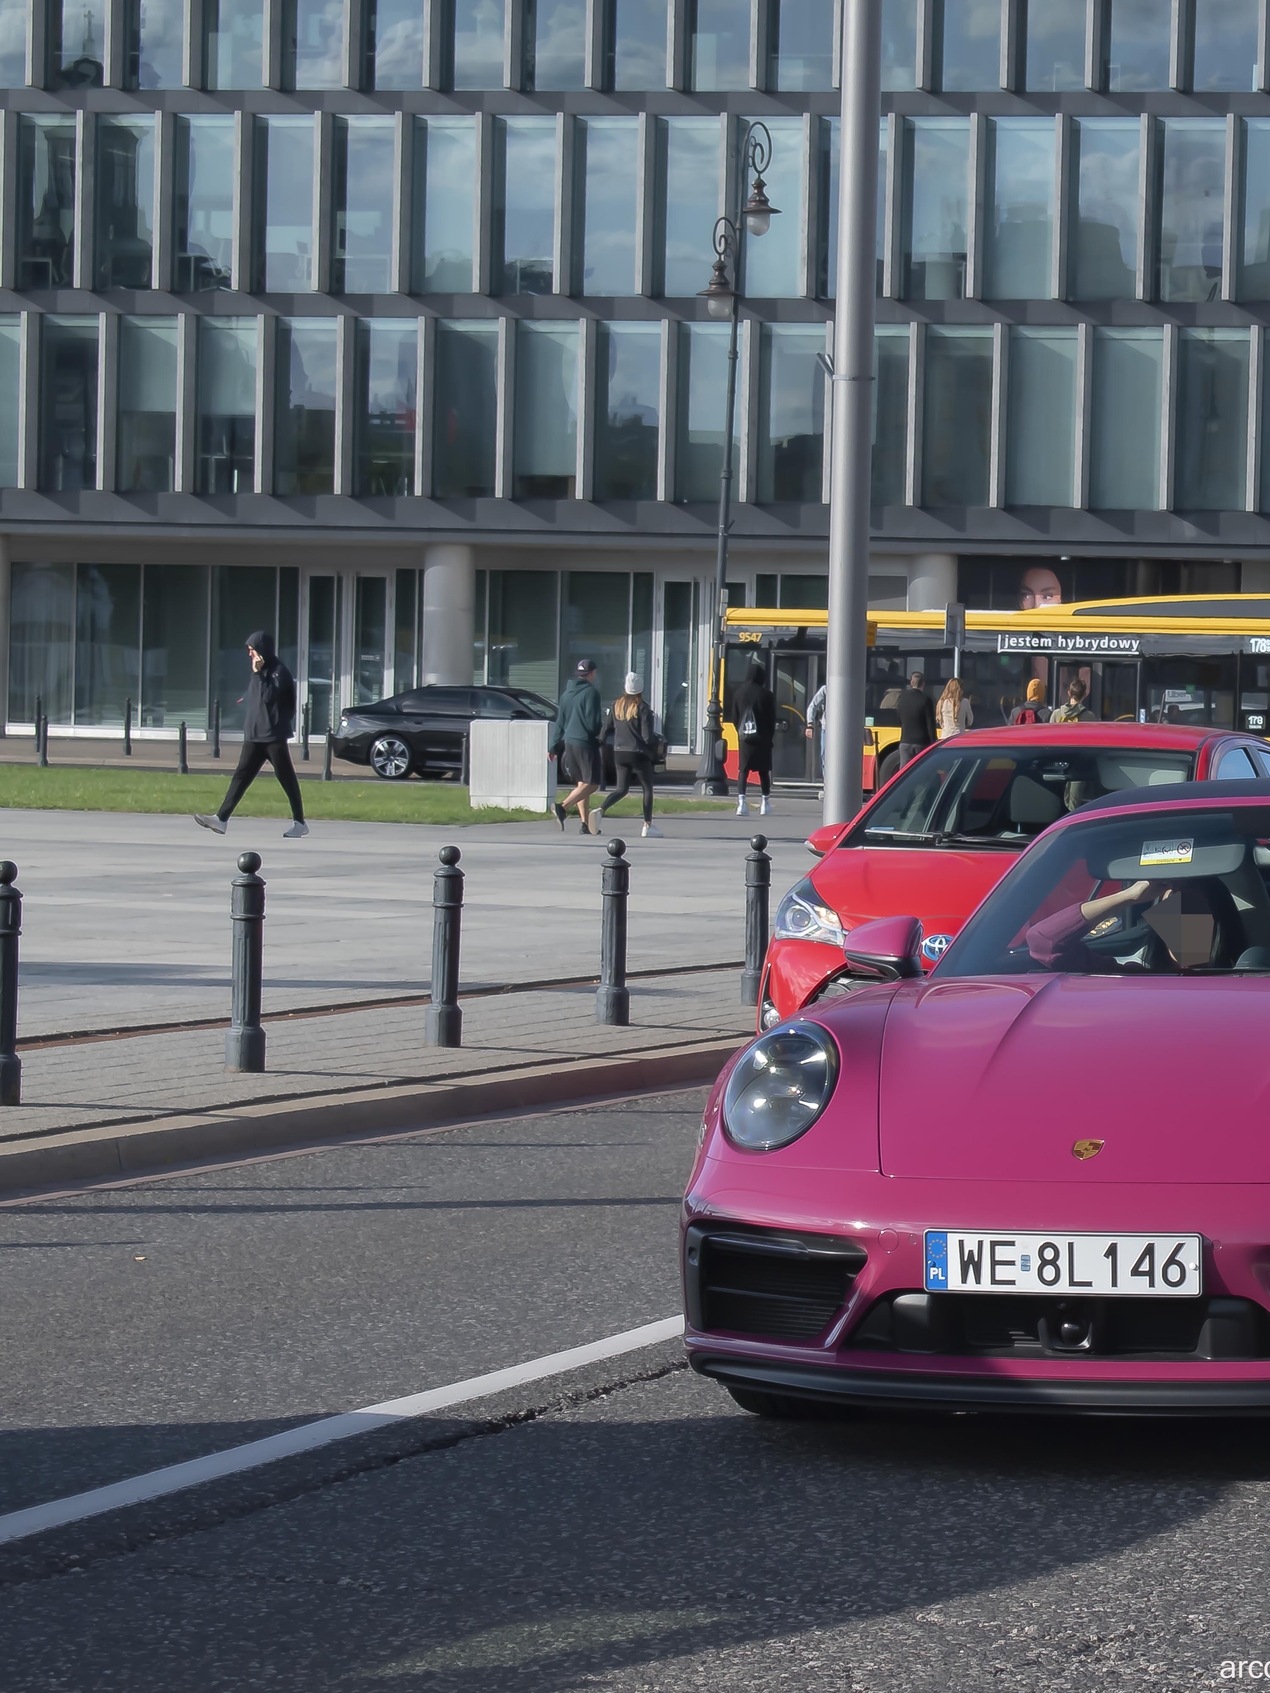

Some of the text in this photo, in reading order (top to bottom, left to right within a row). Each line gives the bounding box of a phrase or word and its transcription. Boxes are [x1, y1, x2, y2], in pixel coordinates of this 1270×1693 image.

[739, 632, 763, 643] 9547
[1004, 634, 1140, 651] jestem hybrydowy
[1250, 638, 1267, 653] 178
[1248, 715, 1264, 725] 178
[957, 1238, 1187, 1288] WE 8L146
[928, 1266, 946, 1282] PL
